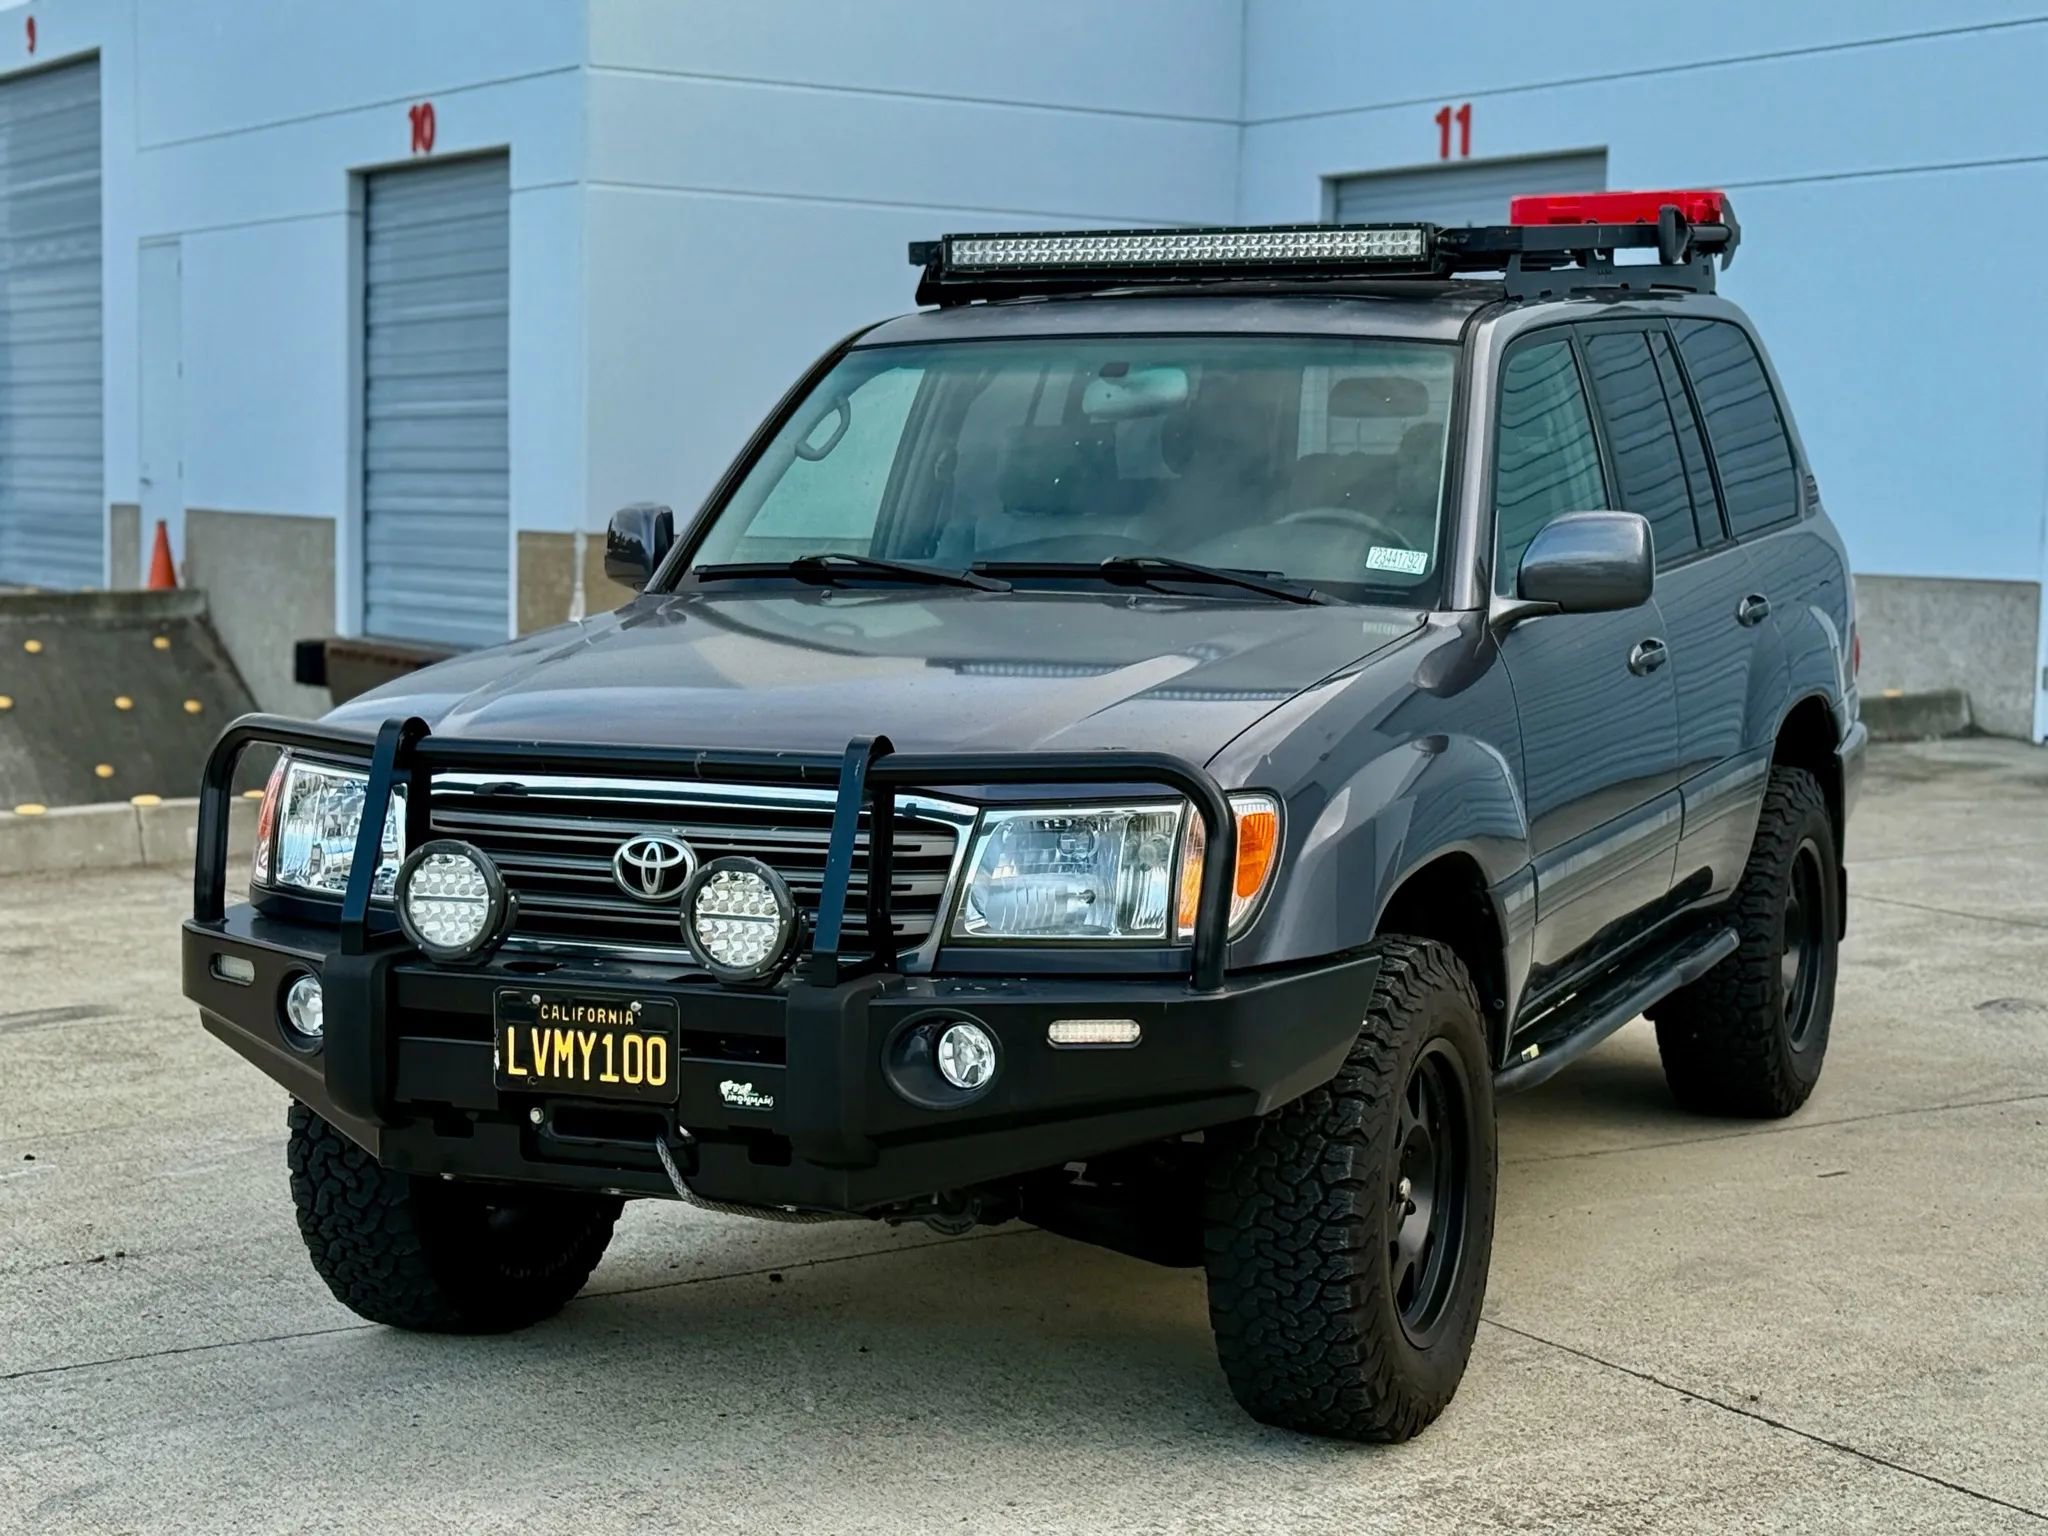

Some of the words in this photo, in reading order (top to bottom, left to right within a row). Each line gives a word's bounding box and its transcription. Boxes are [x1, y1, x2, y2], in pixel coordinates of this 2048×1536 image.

[408, 102, 435, 152] 10
[1435, 103, 1471, 159] 11
[541, 1004, 634, 1025] CALIFORNIA
[507, 1026, 667, 1087] LVMY100
